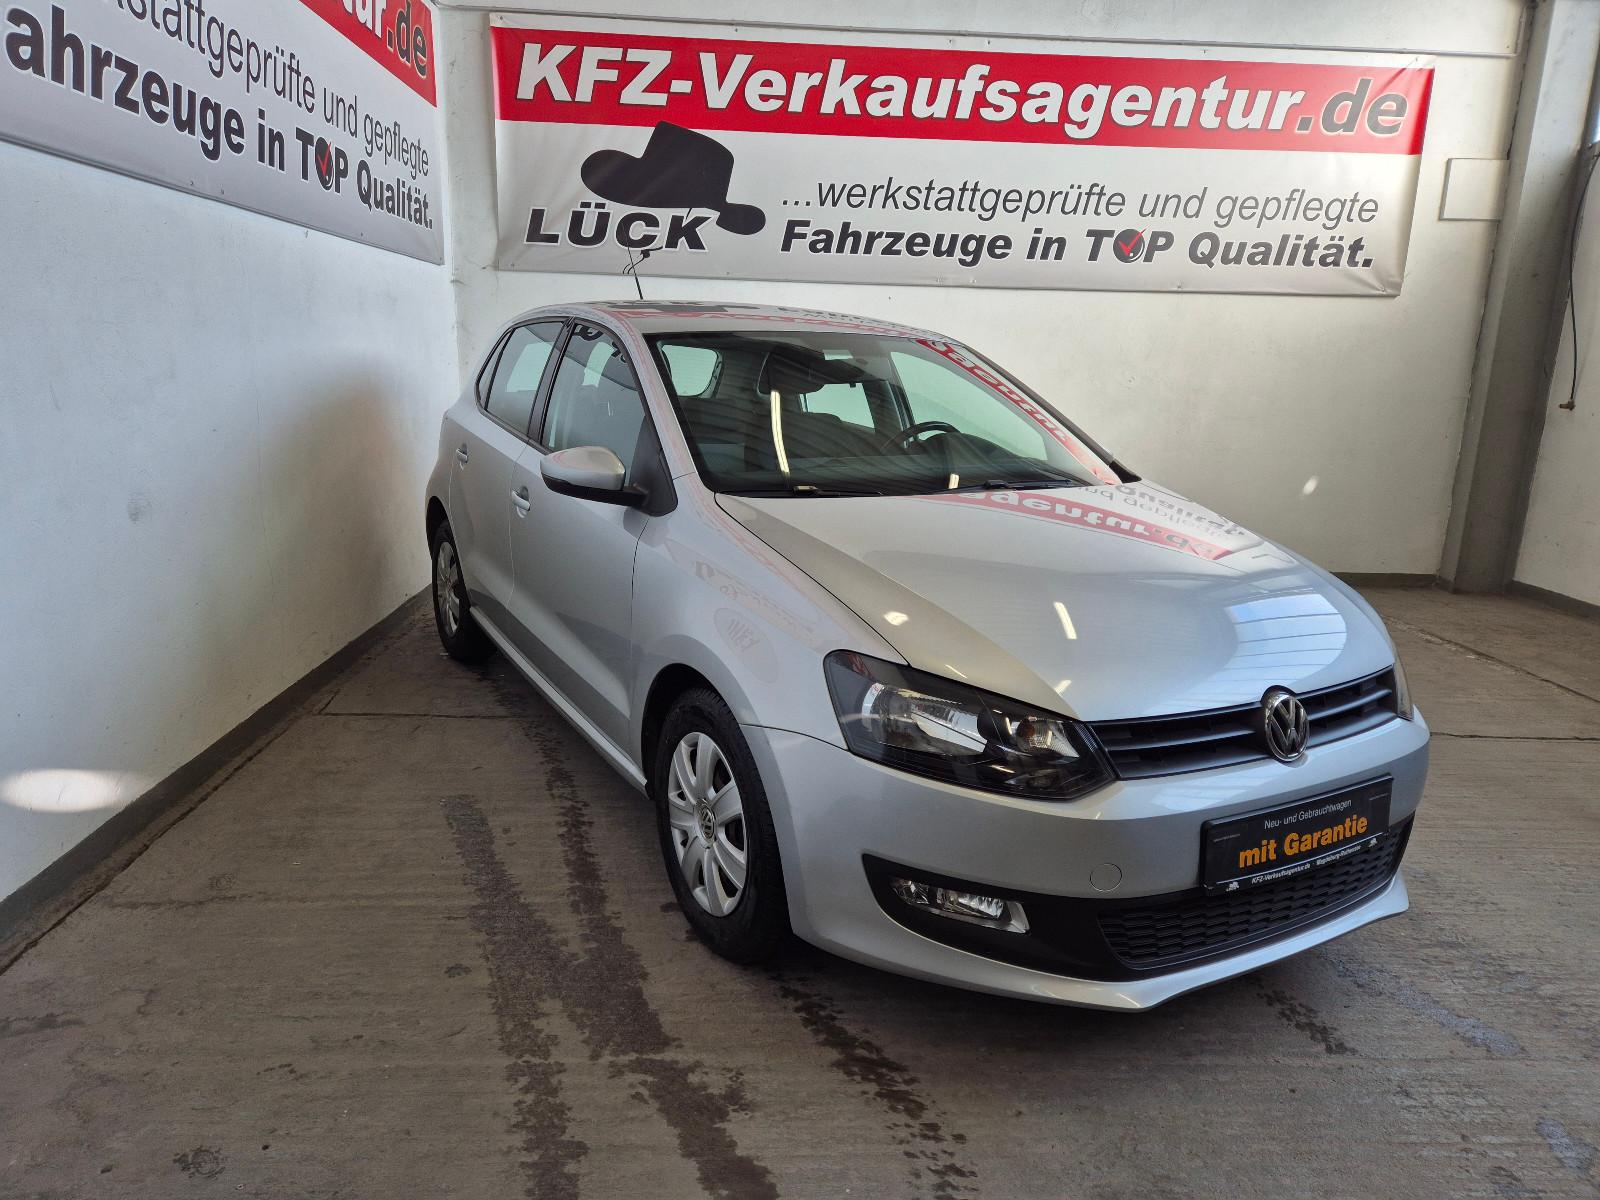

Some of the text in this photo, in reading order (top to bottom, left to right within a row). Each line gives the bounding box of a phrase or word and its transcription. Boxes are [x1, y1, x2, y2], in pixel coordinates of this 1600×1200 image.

[5, 4, 433, 230] ahrzeuge in TOP Qualität.
[515, 42, 1408, 140] KFZ-Verkaufsagentur.de
[323, 87, 358, 138] und
[364, 113, 430, 180] gepflegte
[525, 202, 716, 252] LÜCK
[782, 176, 1379, 231] ...werkstattgeprüfte und gepflegte
[780, 219, 1374, 269] Fahrzeuge in TOP Qualität.
[1239, 814, 1368, 869] mit Garantie
[1264, 799, 1352, 830] Neu- und Gebrauchtwagen
